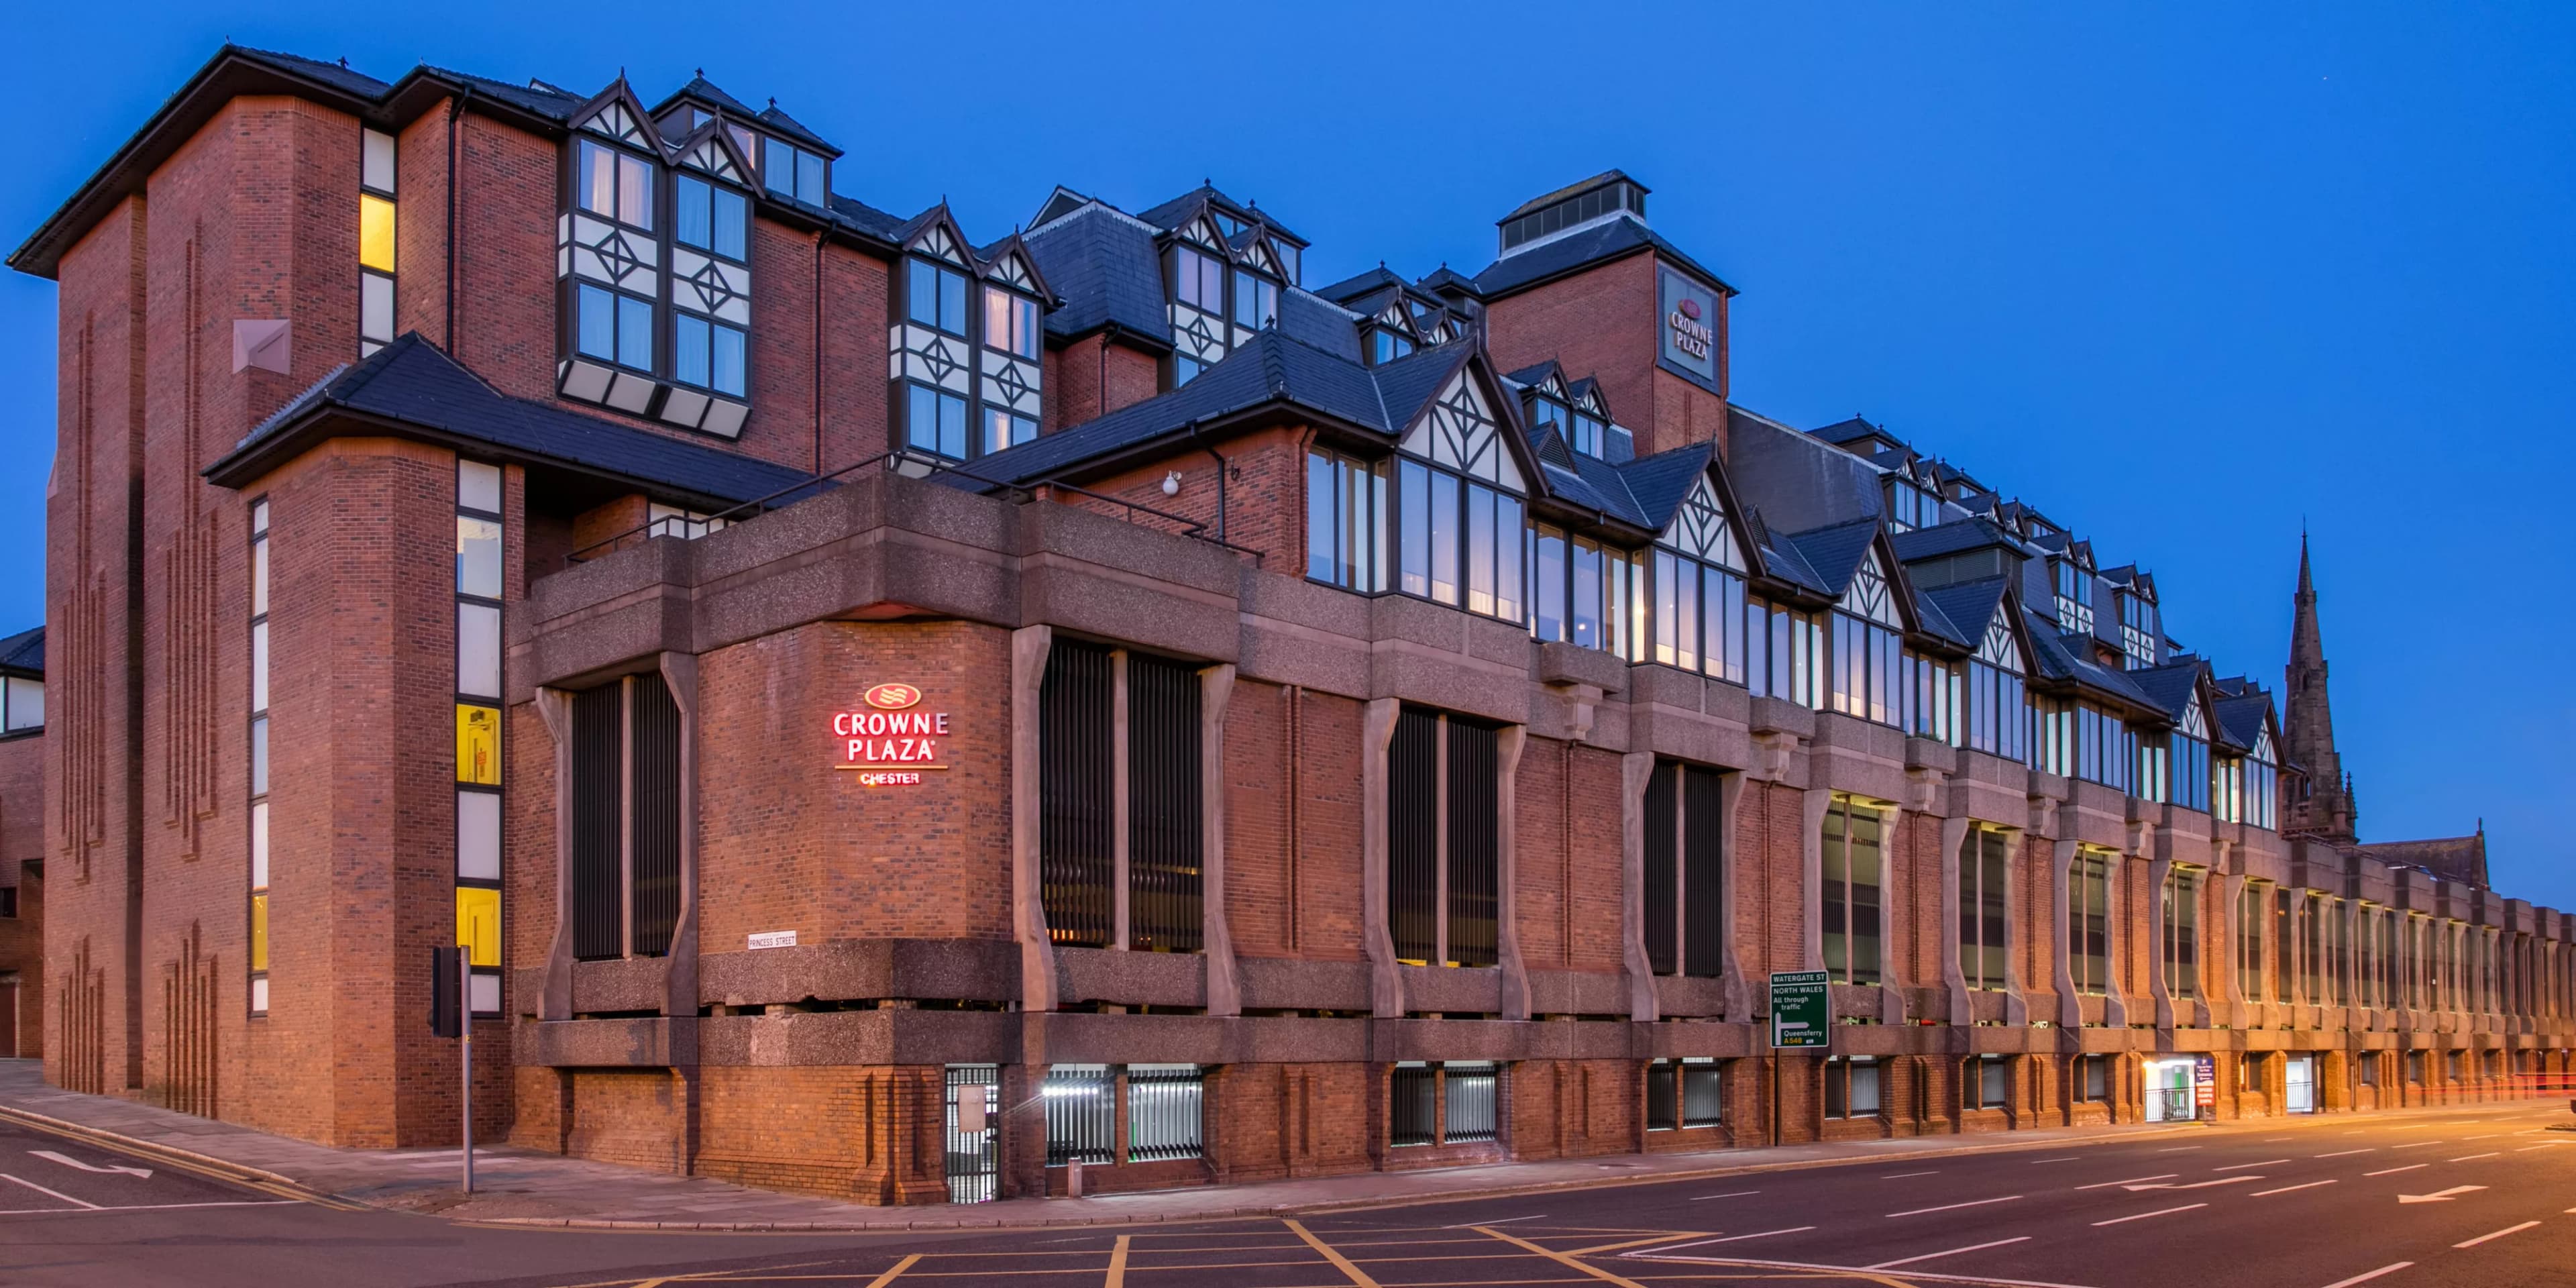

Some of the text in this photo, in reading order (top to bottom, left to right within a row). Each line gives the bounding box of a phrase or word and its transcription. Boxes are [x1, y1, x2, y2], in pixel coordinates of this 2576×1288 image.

[1671, 311, 1713, 345] CROWNE
[1677, 331, 1708, 360] PLAZA
[834, 712, 949, 736] CROWNE
[848, 739, 934, 761] PLAZA
[860, 773, 920, 786] CHESTER
[749, 936, 795, 948] PRINCESS STREET
[1773, 974, 1815, 983] WATERGATE
[1784, 996, 1809, 1004] through
